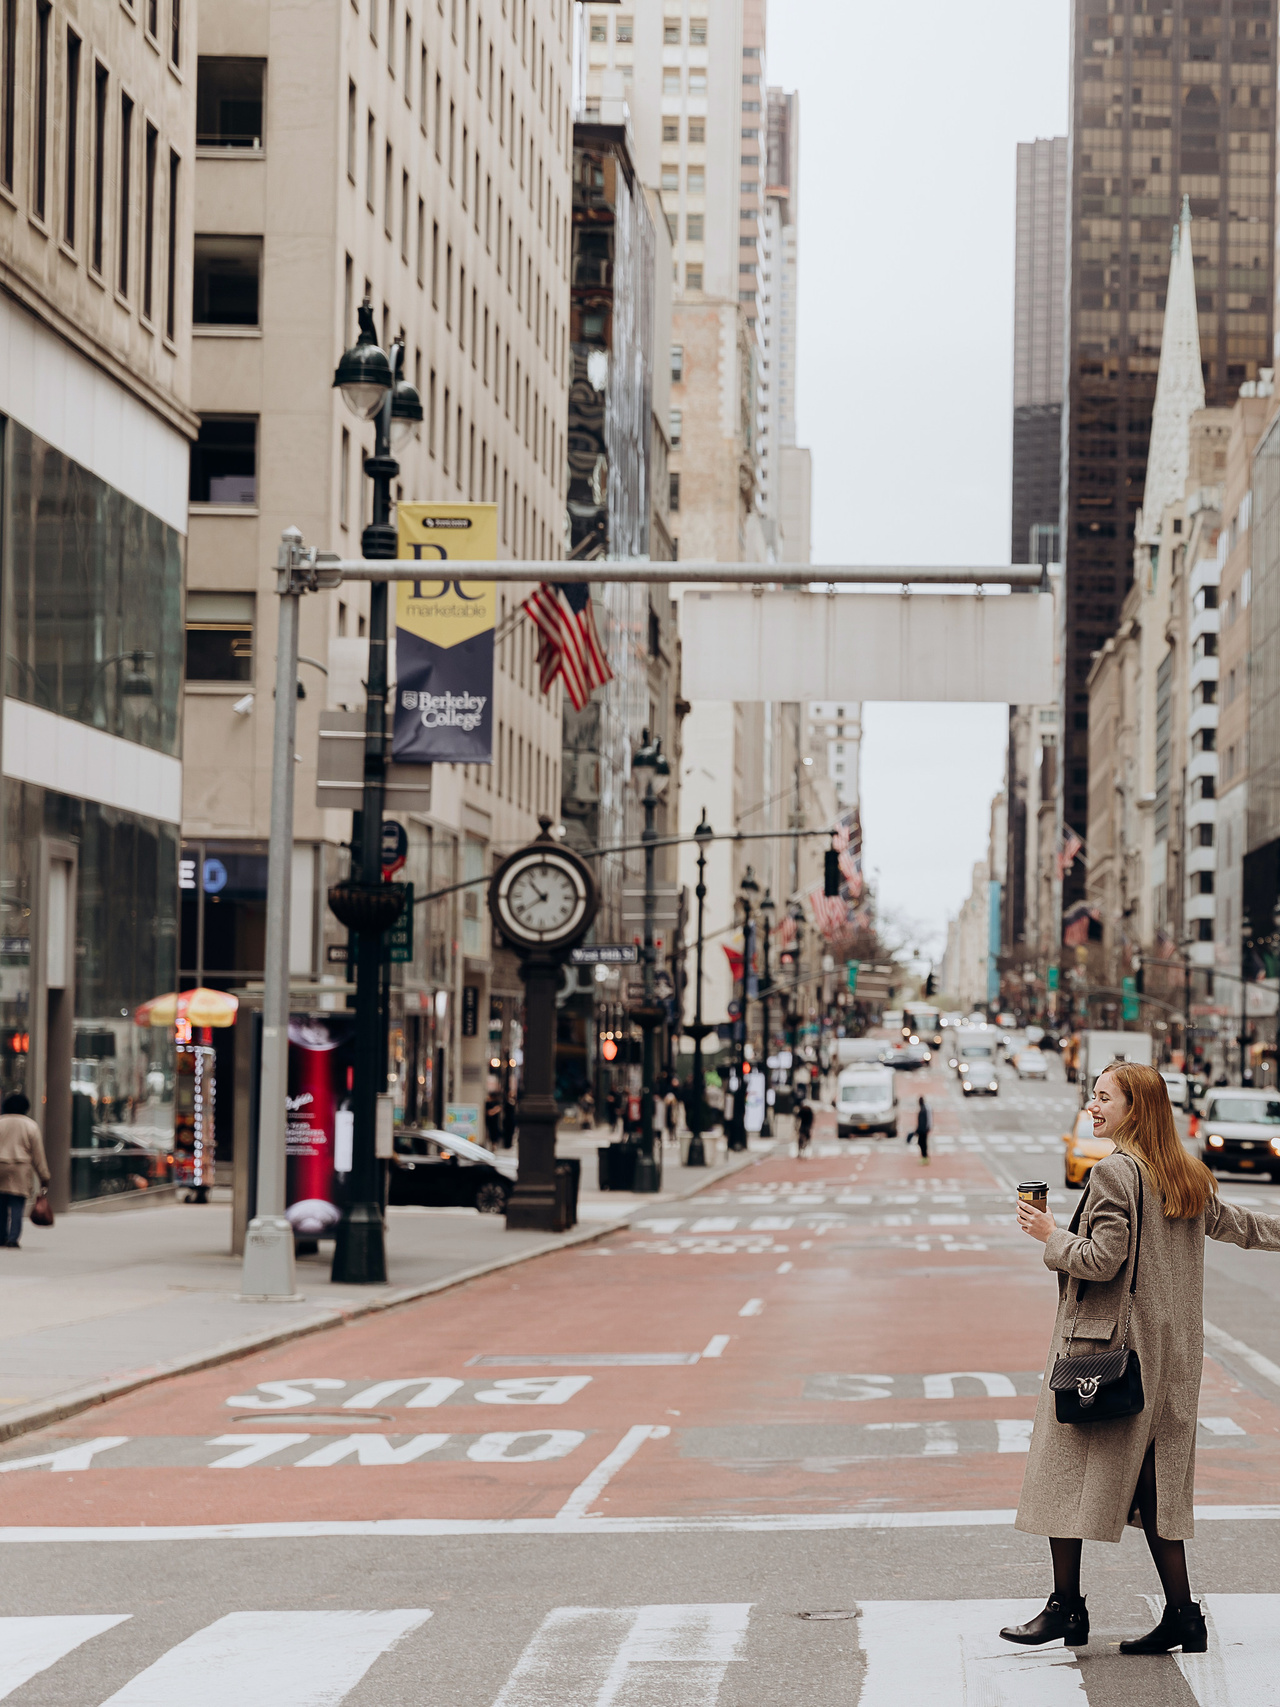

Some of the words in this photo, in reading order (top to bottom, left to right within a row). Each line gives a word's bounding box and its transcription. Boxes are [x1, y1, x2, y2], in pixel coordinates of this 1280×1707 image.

[406, 602, 487, 618] marketable
[418, 690, 487, 714] Berkeley
[421, 709, 482, 731] College
[225, 1375, 593, 1408] BUS
